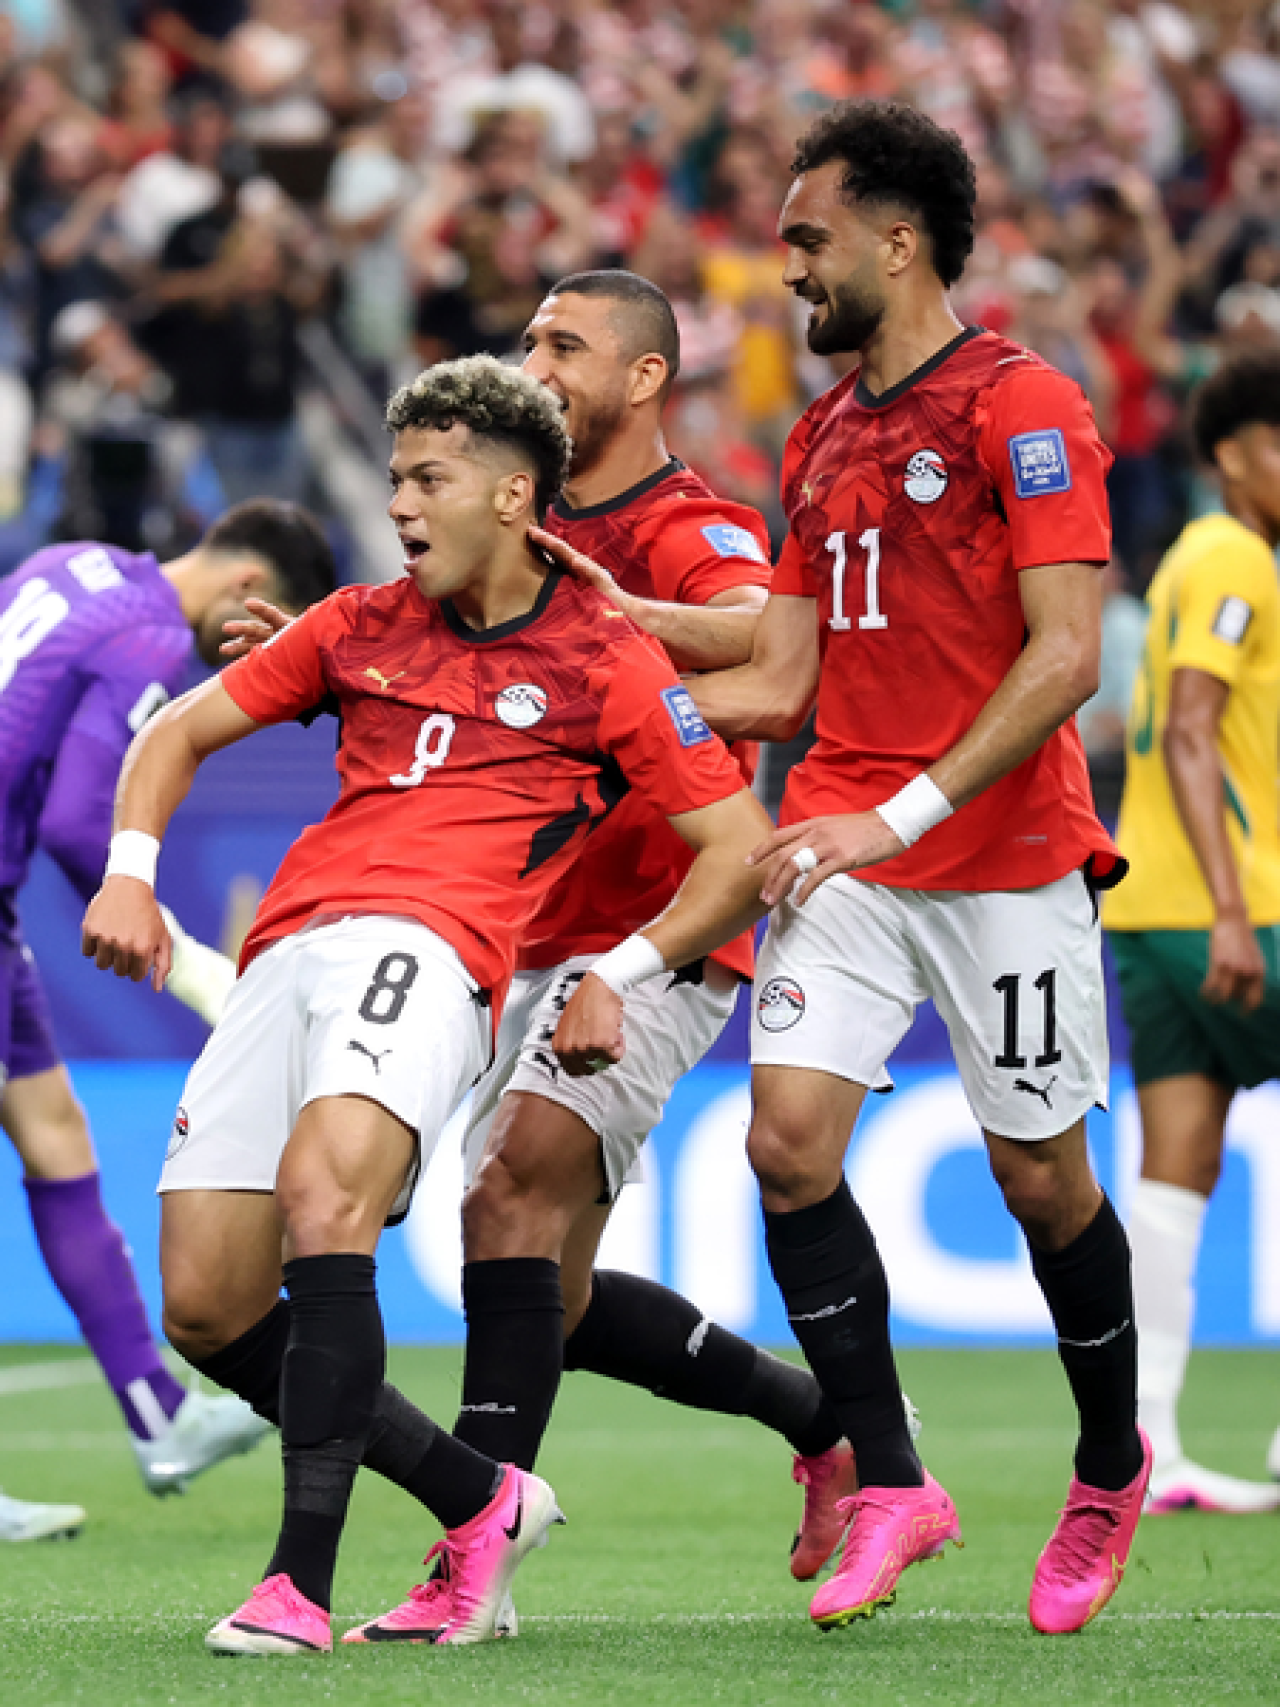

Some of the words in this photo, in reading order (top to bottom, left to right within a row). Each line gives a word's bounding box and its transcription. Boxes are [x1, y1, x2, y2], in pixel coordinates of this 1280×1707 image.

[824, 526, 888, 631] 11
[358, 951, 420, 1024] 8
[993, 968, 1061, 1068] 11
